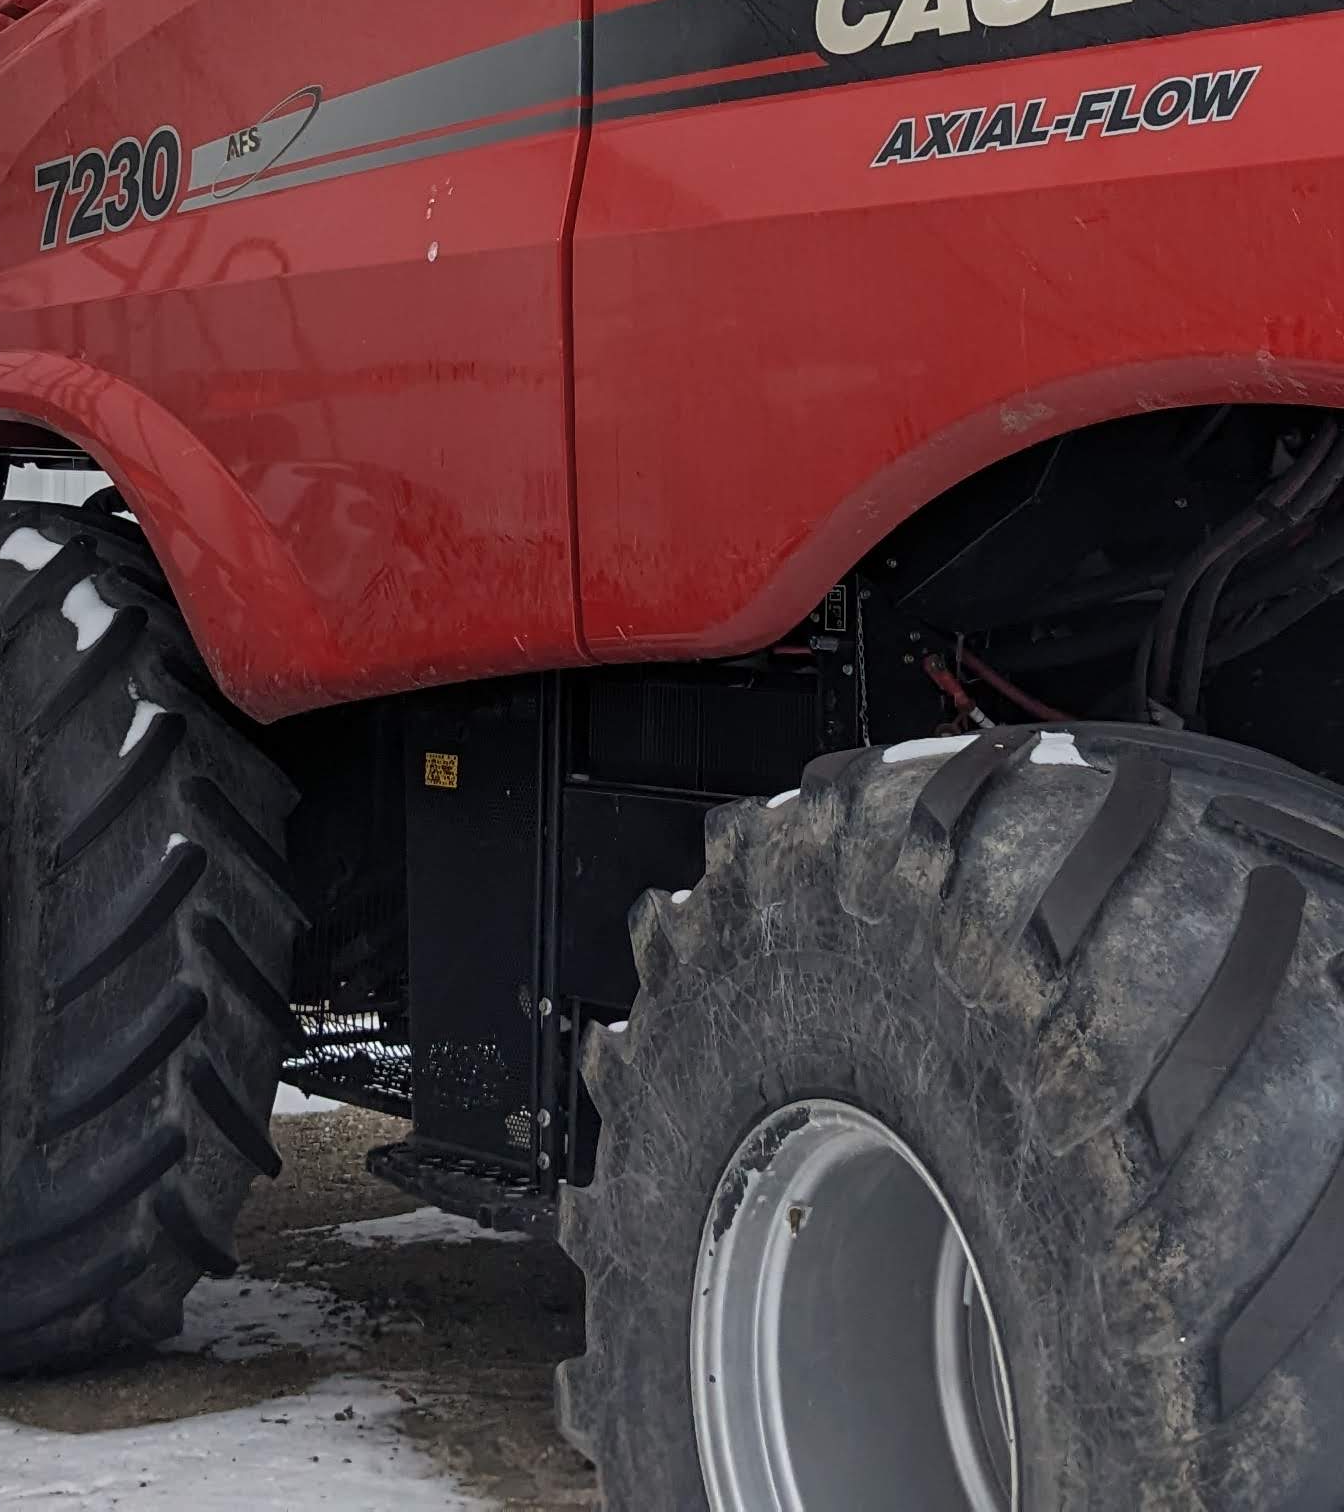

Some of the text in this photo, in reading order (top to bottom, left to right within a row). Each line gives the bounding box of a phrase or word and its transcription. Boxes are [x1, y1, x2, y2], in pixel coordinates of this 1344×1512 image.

[226, 127, 262, 162] AFS
[870, 67, 1262, 167] AXIAL-FLOW
[35, 125, 181, 251] 7230
